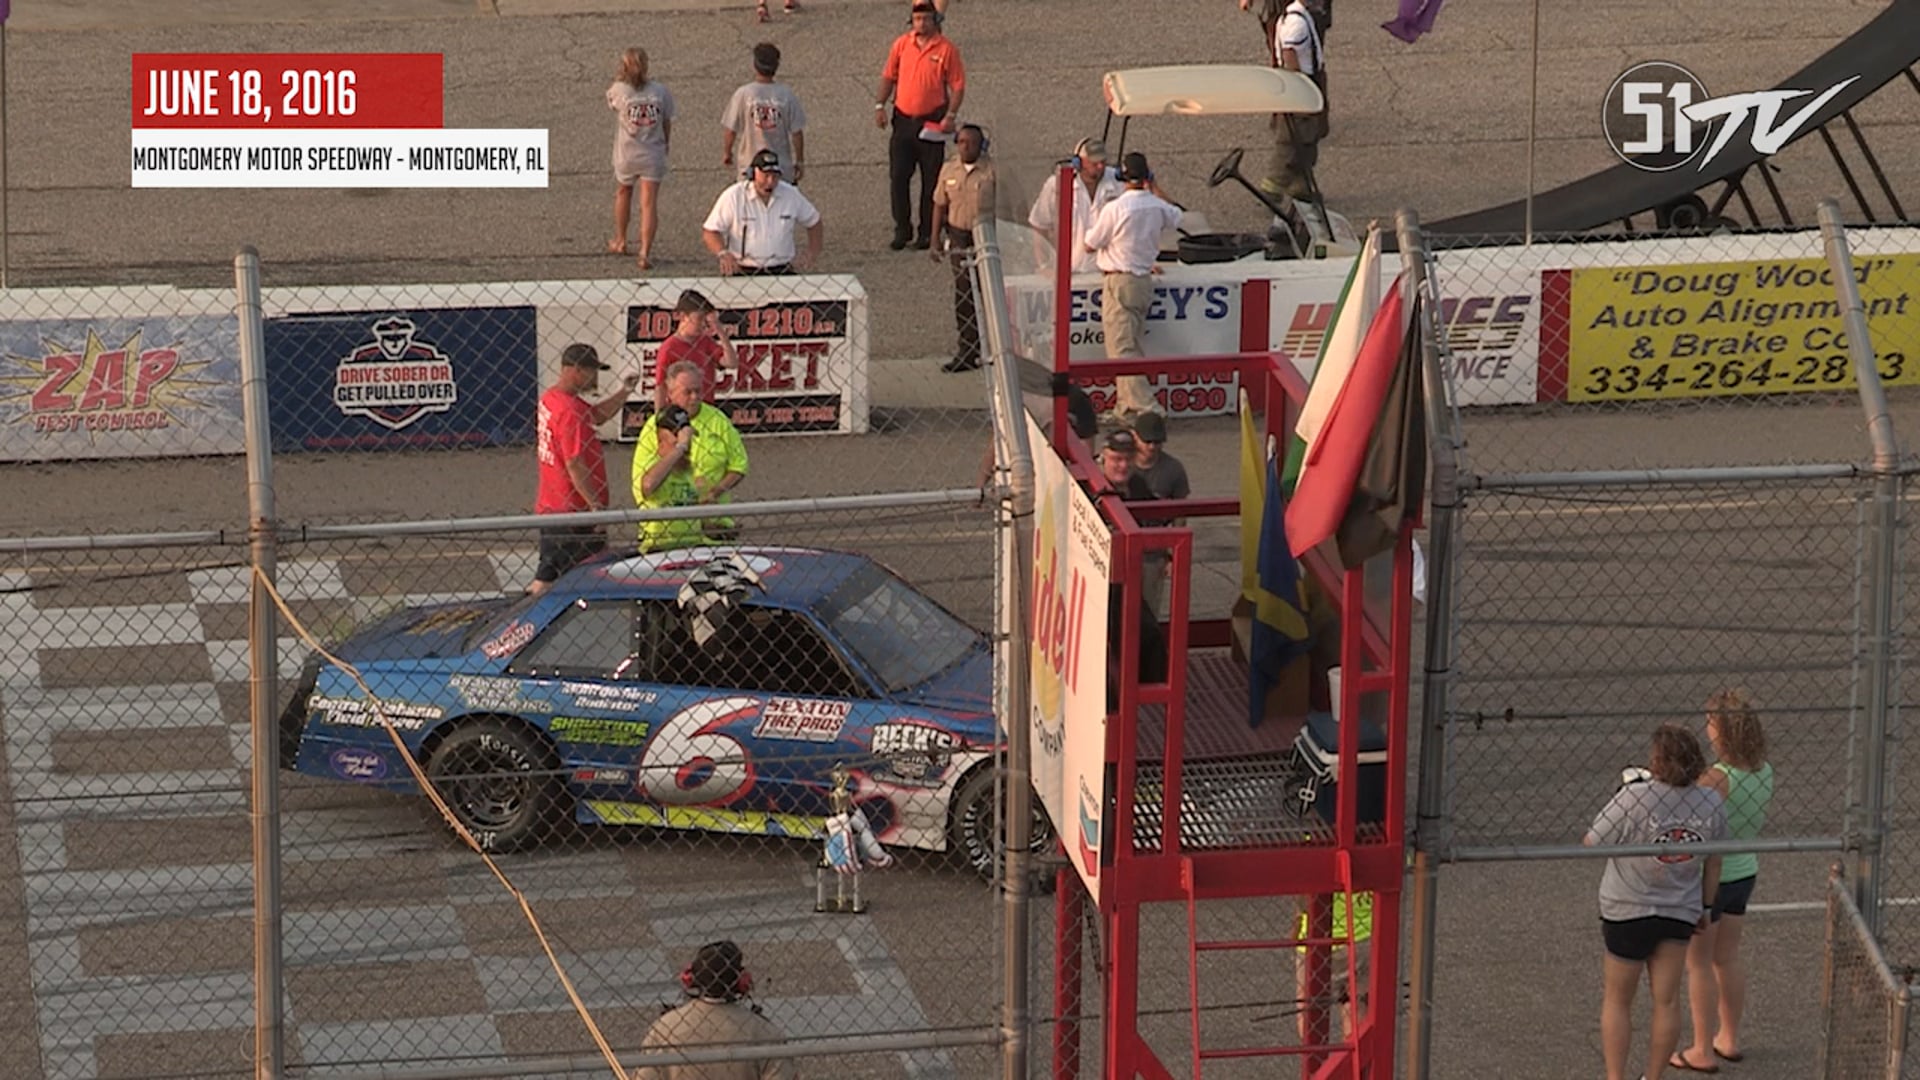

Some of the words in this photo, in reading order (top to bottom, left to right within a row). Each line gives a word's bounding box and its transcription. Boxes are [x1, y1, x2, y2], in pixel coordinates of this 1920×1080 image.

[1021, 286, 1229, 324] WESEY'S
[1588, 304, 1688, 330] Auto
[1696, 293, 1910, 327] Alignmnt
[745, 307, 814, 337] 1210
[1628, 335, 1655, 360] &
[1670, 331, 1789, 359] Brake
[31, 349, 179, 412] ZAP
[339, 367, 380, 385] DRIVE
[383, 365, 429, 383] SOBER
[430, 364, 450, 381] OR
[337, 385, 363, 402] GET
[365, 384, 416, 401] PULLED
[417, 383, 453, 400] OVER
[35, 414, 83, 433] PEST
[84, 411, 170, 431] CONTROL
[308, 694, 367, 713] Central
[767, 700, 847, 716] SEXTON
[549, 716, 650, 737] SHOWTIME
[758, 714, 797, 735] TIRE
[794, 716, 844, 737] PROS
[637, 696, 763, 808] 6
